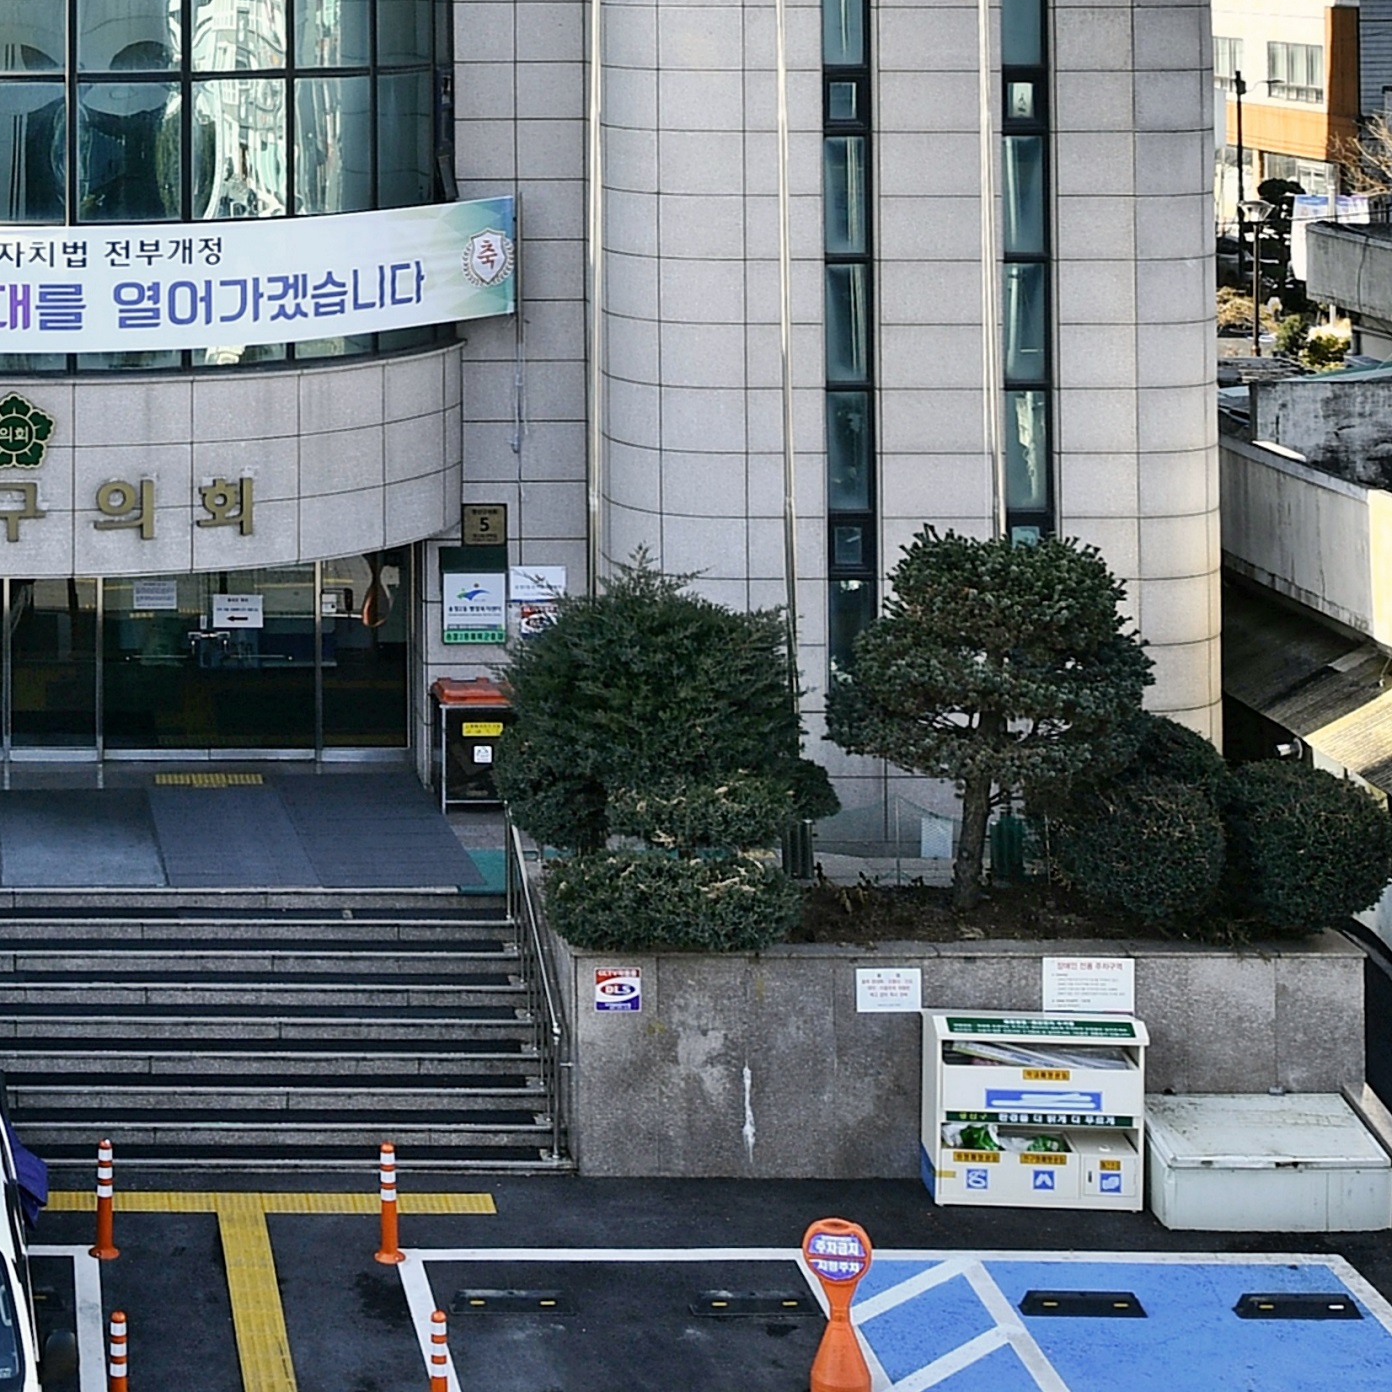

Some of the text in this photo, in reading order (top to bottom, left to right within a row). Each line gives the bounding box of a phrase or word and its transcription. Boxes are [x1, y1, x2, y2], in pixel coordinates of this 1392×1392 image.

[104, 236, 223, 267] 전부개정
[477, 239, 498, 270] 축
[112, 260, 426, 330] 열어가겠습니다
[480, 517, 490, 532] 5
[815, 1241, 860, 1256] 주차금지
